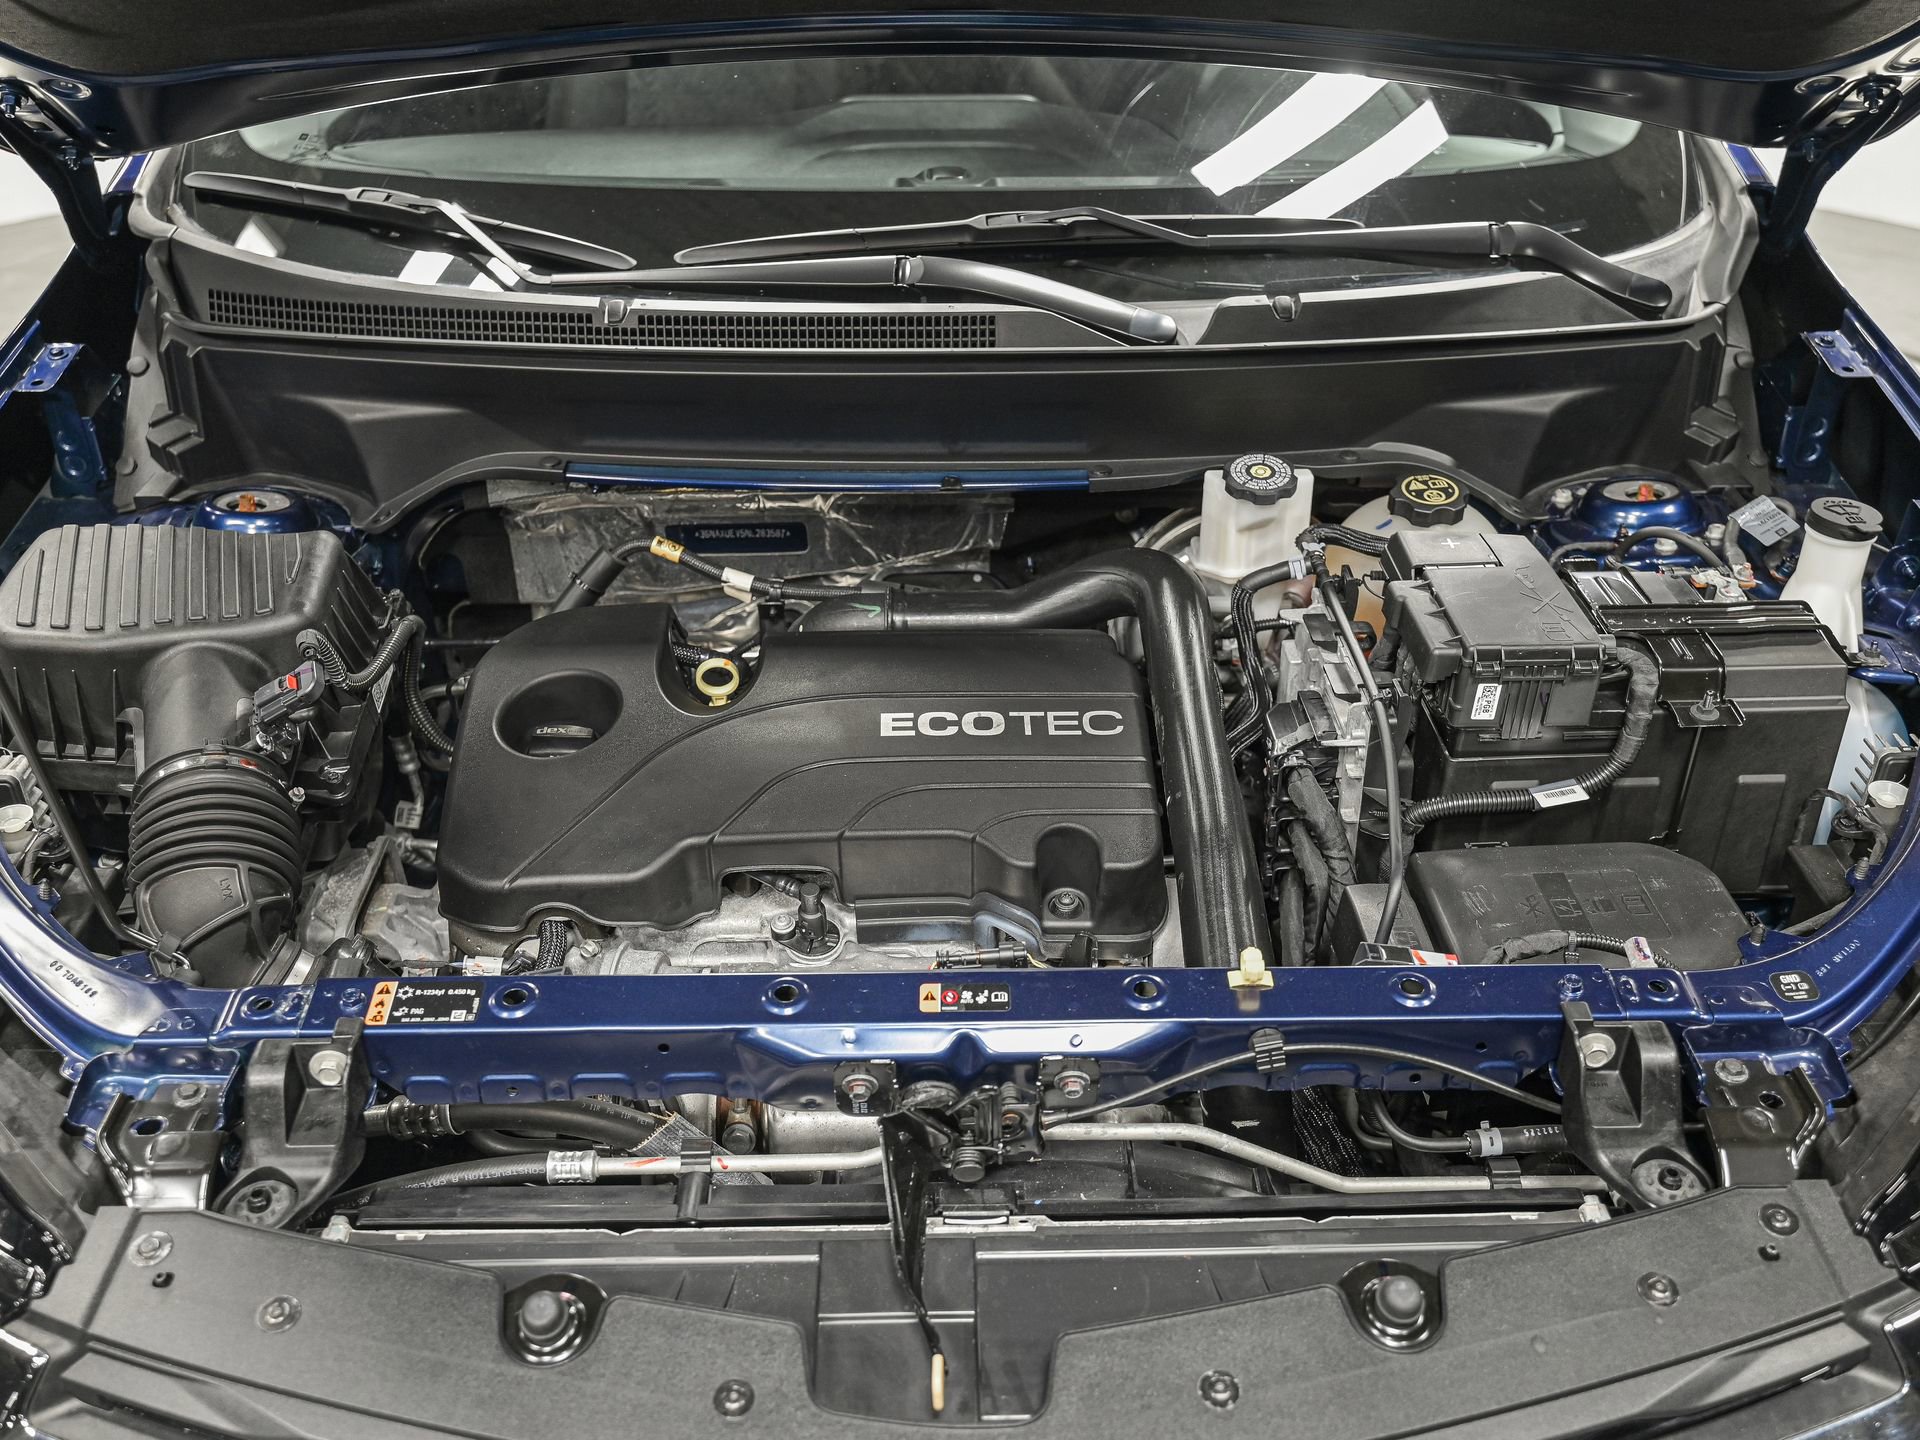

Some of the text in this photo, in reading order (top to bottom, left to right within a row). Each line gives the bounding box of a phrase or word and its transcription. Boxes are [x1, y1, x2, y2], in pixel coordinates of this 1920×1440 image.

[880, 710, 1124, 736] ECOTEC
[1779, 974, 1802, 984] GND
[415, 989, 446, 997] R-1234yf
[409, 1007, 425, 1015] PAG
